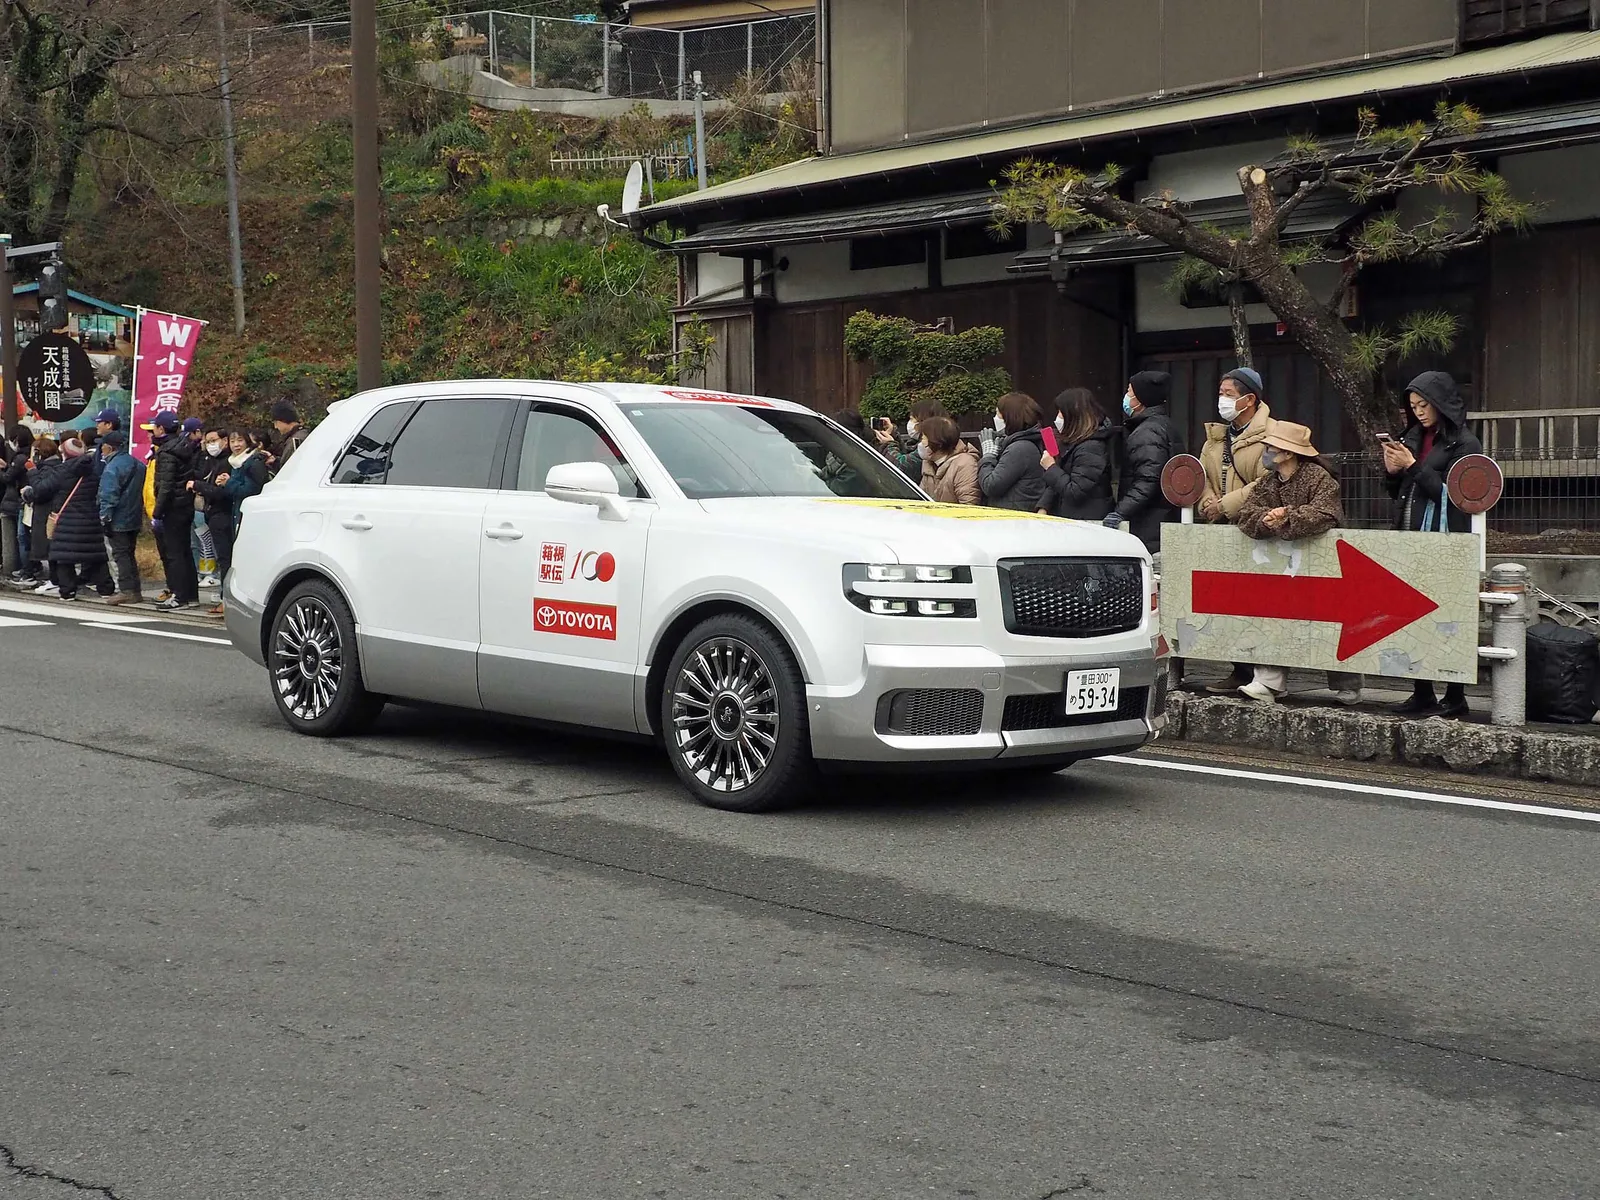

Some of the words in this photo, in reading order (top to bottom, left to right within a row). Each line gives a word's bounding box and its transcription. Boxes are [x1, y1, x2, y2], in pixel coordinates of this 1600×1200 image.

[42, 346, 61, 410] 天成園
[541, 544, 565, 562] 箱根
[540, 563, 563, 581] 駅伝
[557, 610, 613, 631] TOYOTA
[1078, 686, 1115, 709] 59-34
